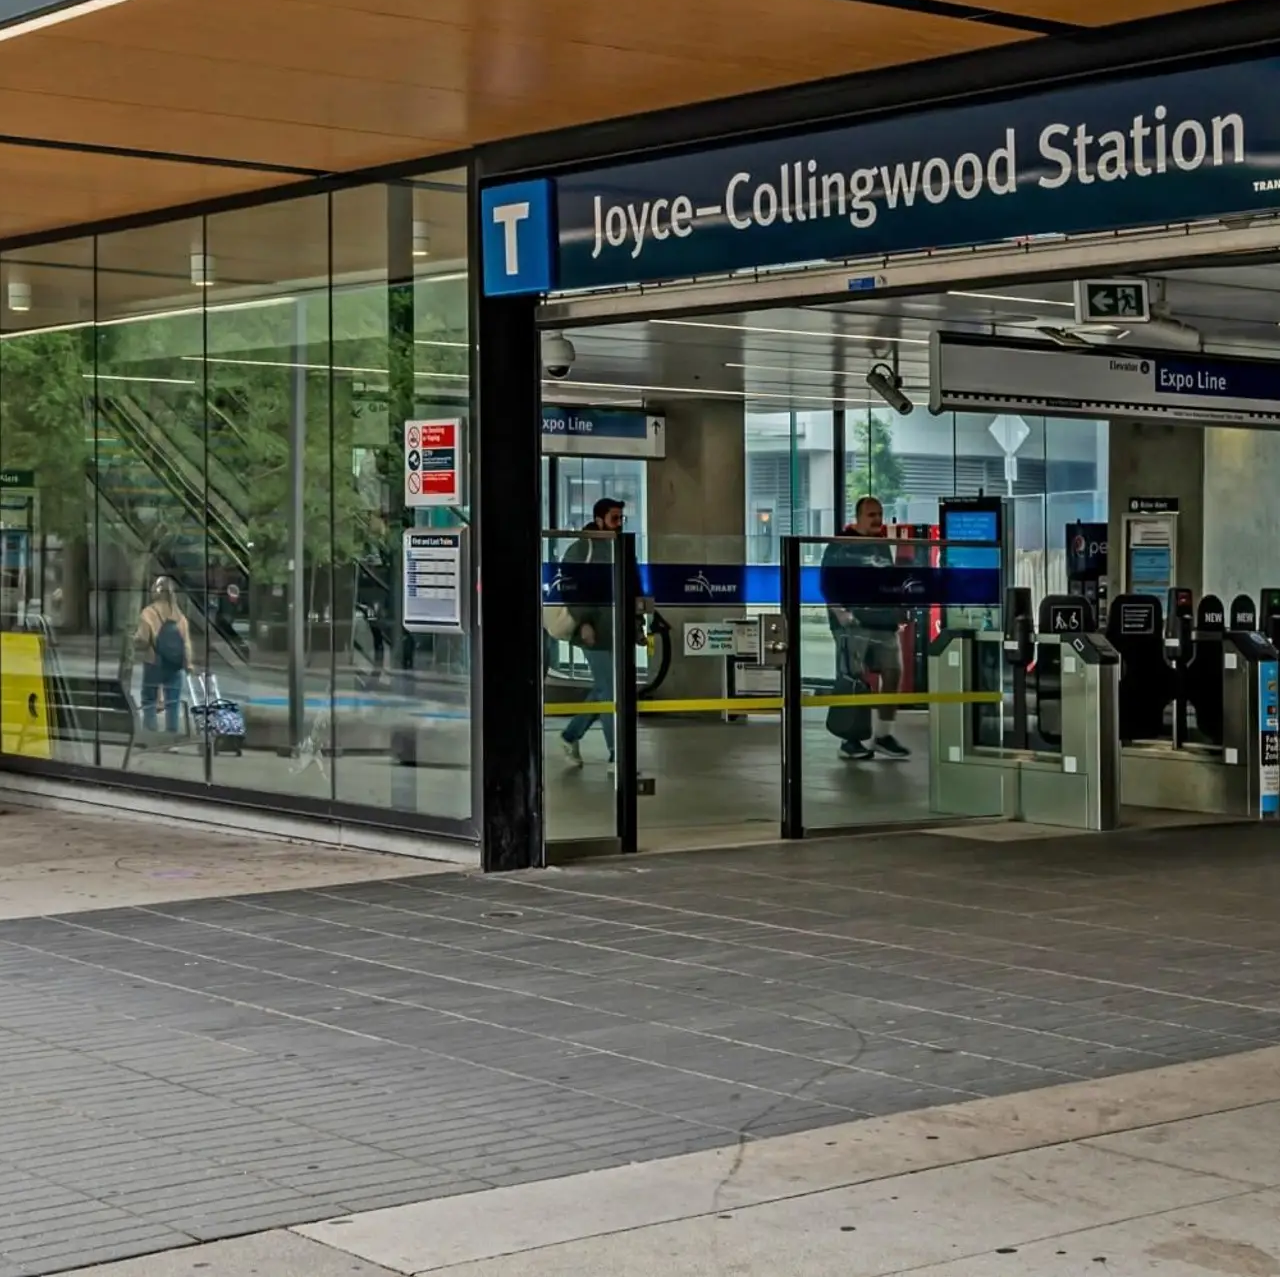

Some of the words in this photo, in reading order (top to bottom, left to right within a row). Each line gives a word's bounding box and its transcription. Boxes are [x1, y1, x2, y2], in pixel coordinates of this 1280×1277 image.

[1038, 105, 1245, 189] Station
[493, 202, 530, 276] T
[1109, 359, 1138, 373] Elevator
[1160, 368, 1194, 392] Expo
[1197, 371, 1228, 391] Line
[542, 418, 565, 432] xpo
[568, 416, 593, 431] Line
[1205, 613, 1222, 622] NEW
[1237, 613, 1253, 622] NEW
